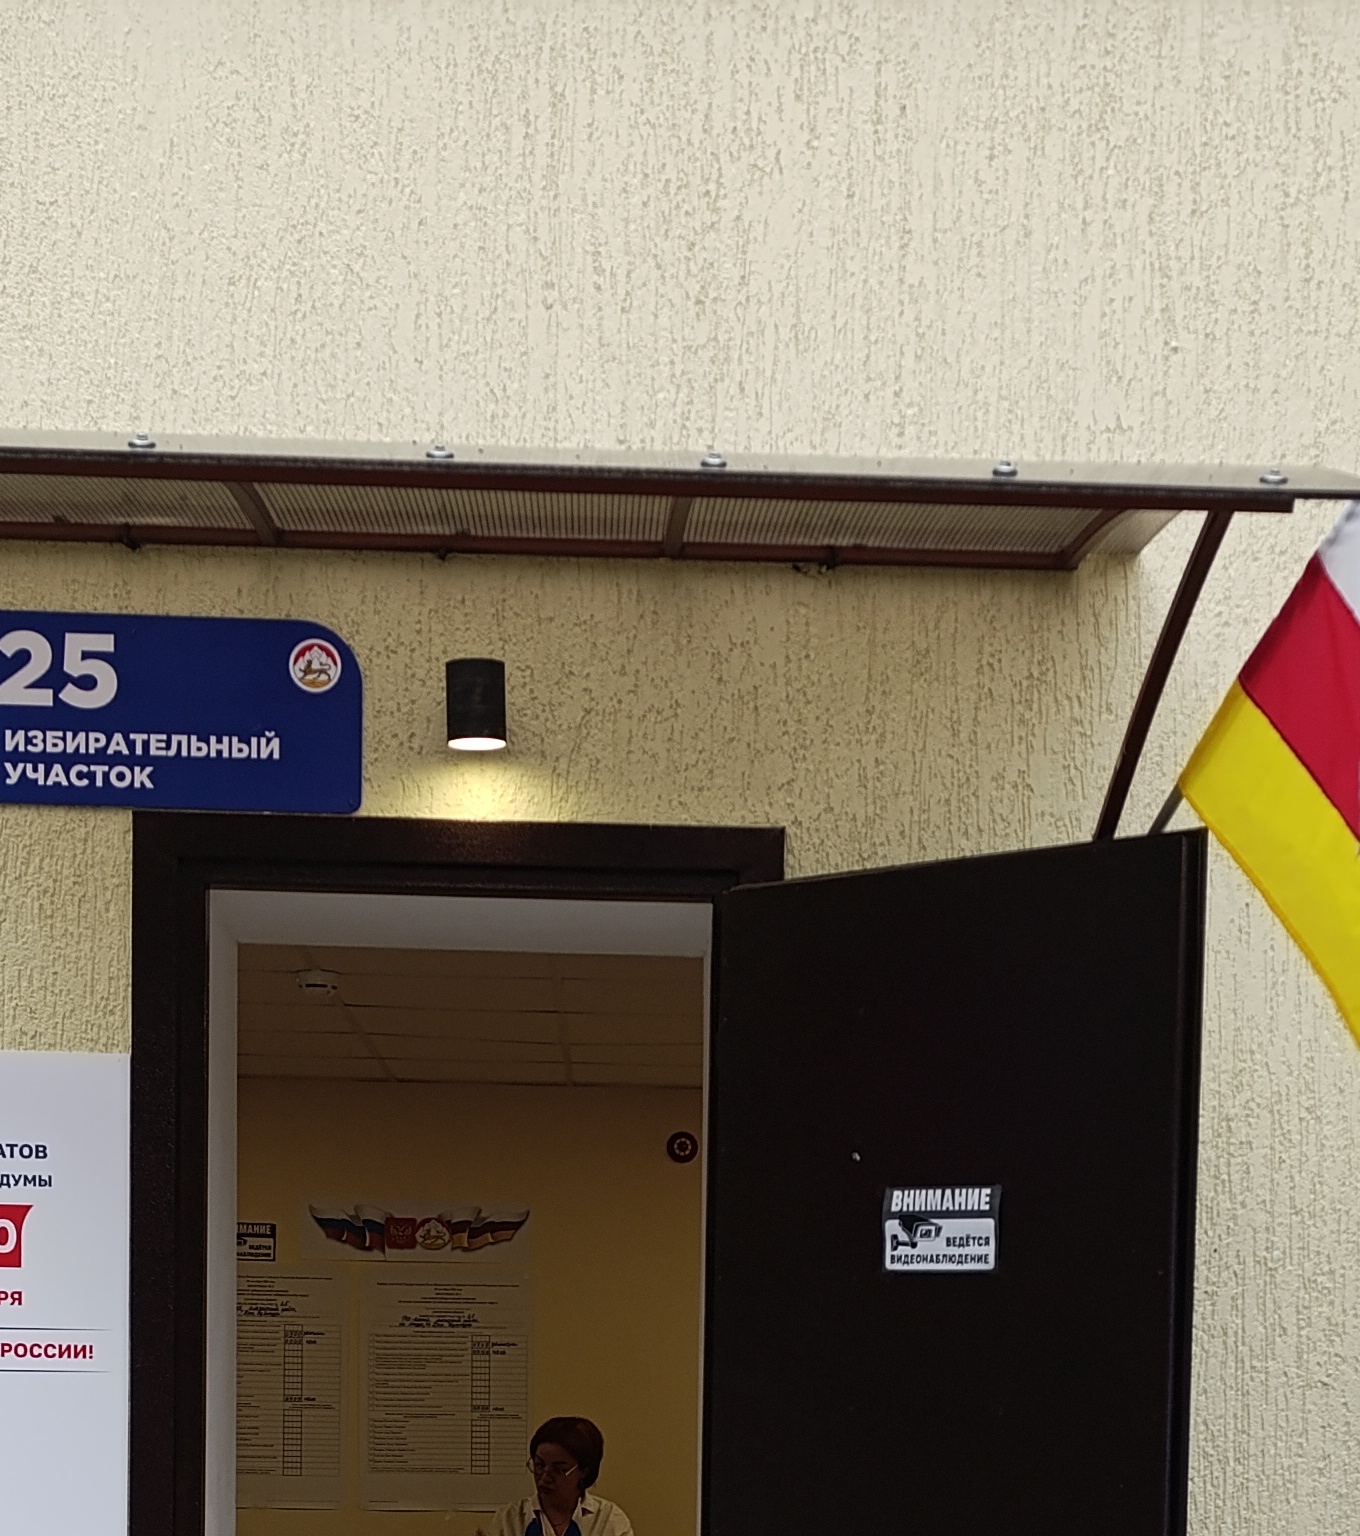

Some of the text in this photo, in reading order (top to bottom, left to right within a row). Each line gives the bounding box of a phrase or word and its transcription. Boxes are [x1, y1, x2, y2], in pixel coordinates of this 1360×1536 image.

[4, 730, 280, 759] ИЗБИРАТЕЛЬНЫЙ
[4, 762, 154, 789] УЧАСТОК
[0, 1174, 52, 1188] ДУМЫ
[891, 1188, 991, 1212] ВНИМАНИЕ
[237, 1224, 271, 1235] МАНИЕ
[946, 1234, 990, 1248] ВЕДЁТСЯ
[890, 1254, 989, 1266] ВИДЕОНАБЛЮДЕНИЕ
[1, 1343, 93, 1359] РОССИИ!
